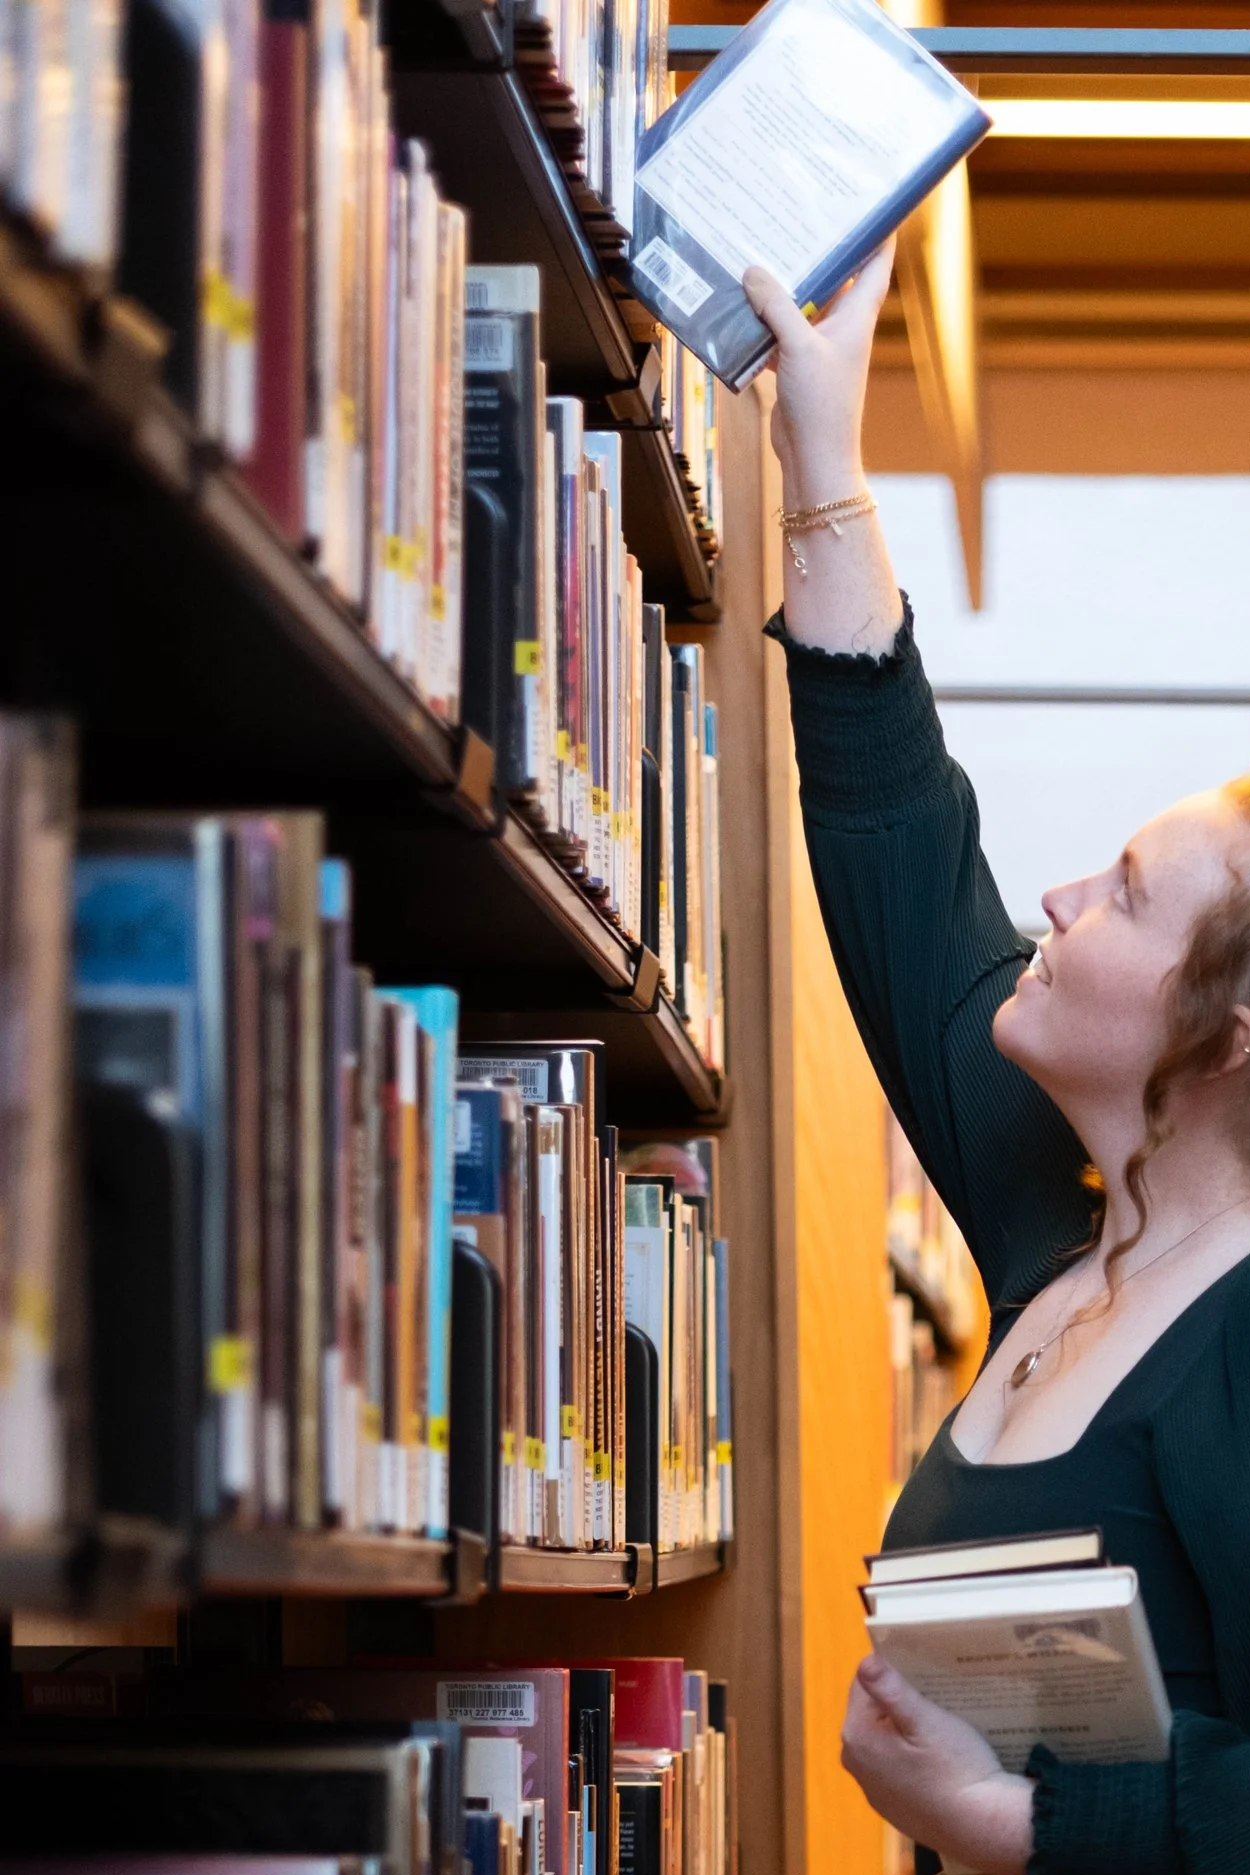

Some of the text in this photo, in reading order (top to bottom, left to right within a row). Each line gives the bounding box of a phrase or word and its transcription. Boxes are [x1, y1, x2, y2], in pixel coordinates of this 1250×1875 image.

[460, 1059, 492, 1067] TORONTO
[517, 1060, 544, 1068] LIBRARY
[522, 1086, 538, 1095] 018
